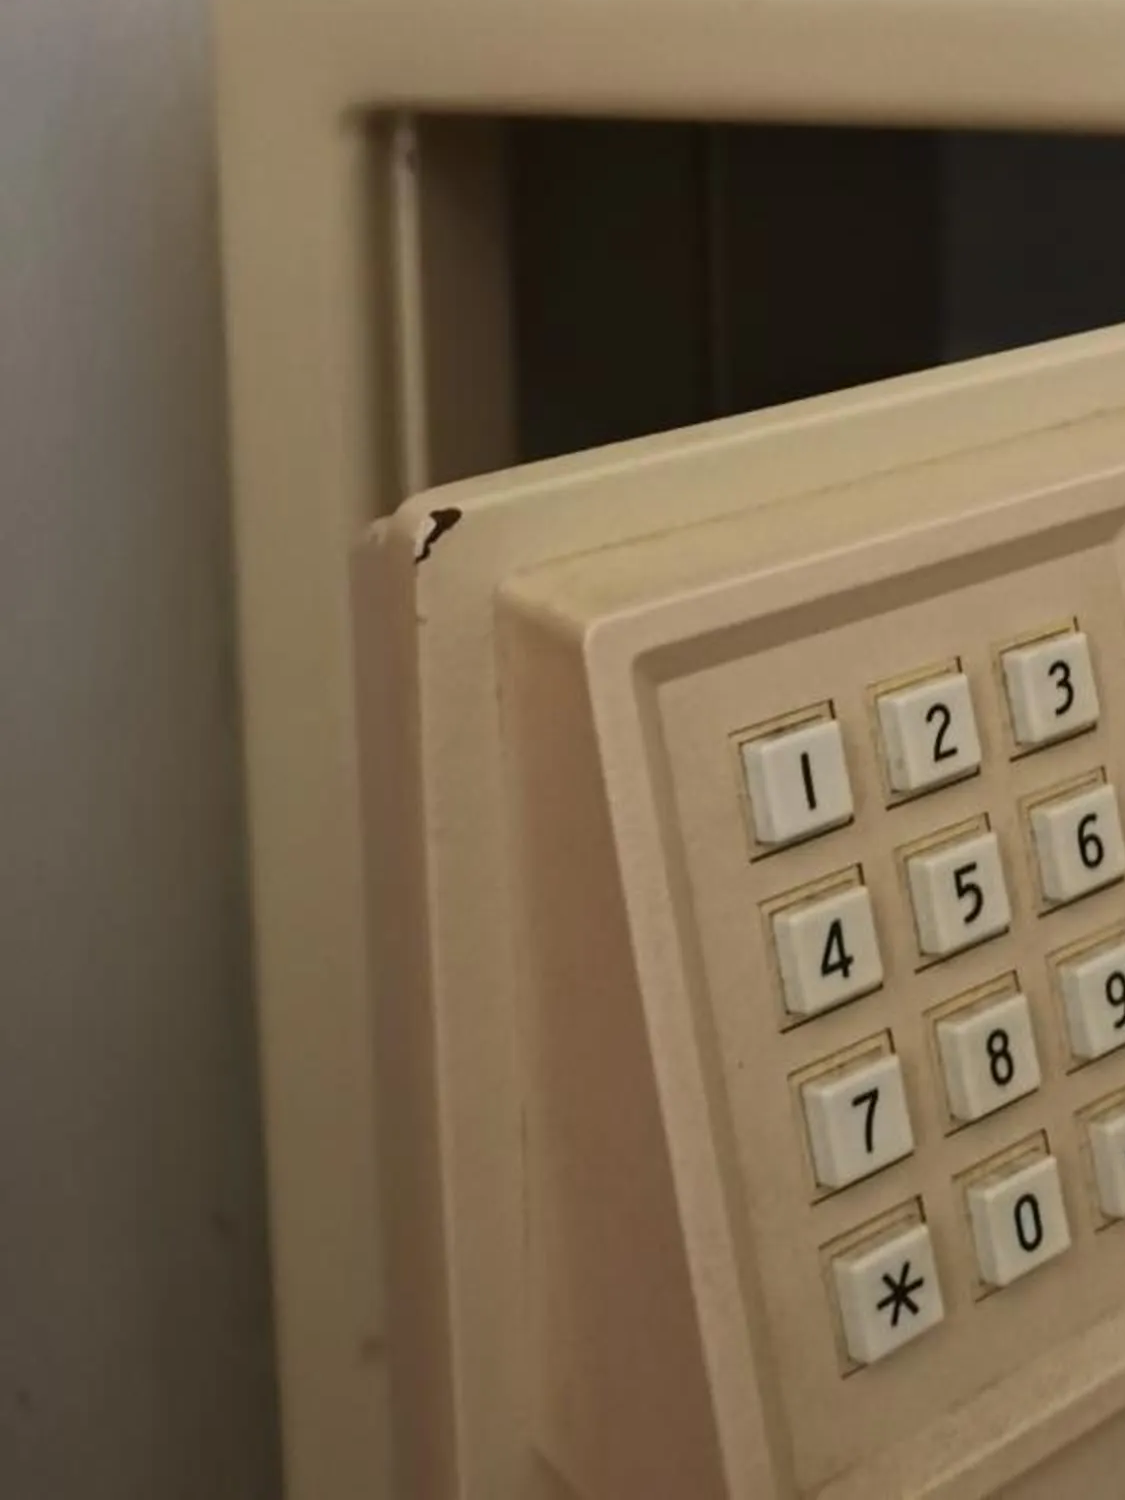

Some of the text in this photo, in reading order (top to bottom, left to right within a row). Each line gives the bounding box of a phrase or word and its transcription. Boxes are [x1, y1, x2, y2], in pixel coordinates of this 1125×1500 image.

[800, 659, 1075, 811] 1 2 3
[820, 812, 1105, 979] 4 5 6
[851, 1087, 880, 1154] 7
[985, 1028, 1015, 1087] 8
[1013, 1193, 1044, 1253] 0
